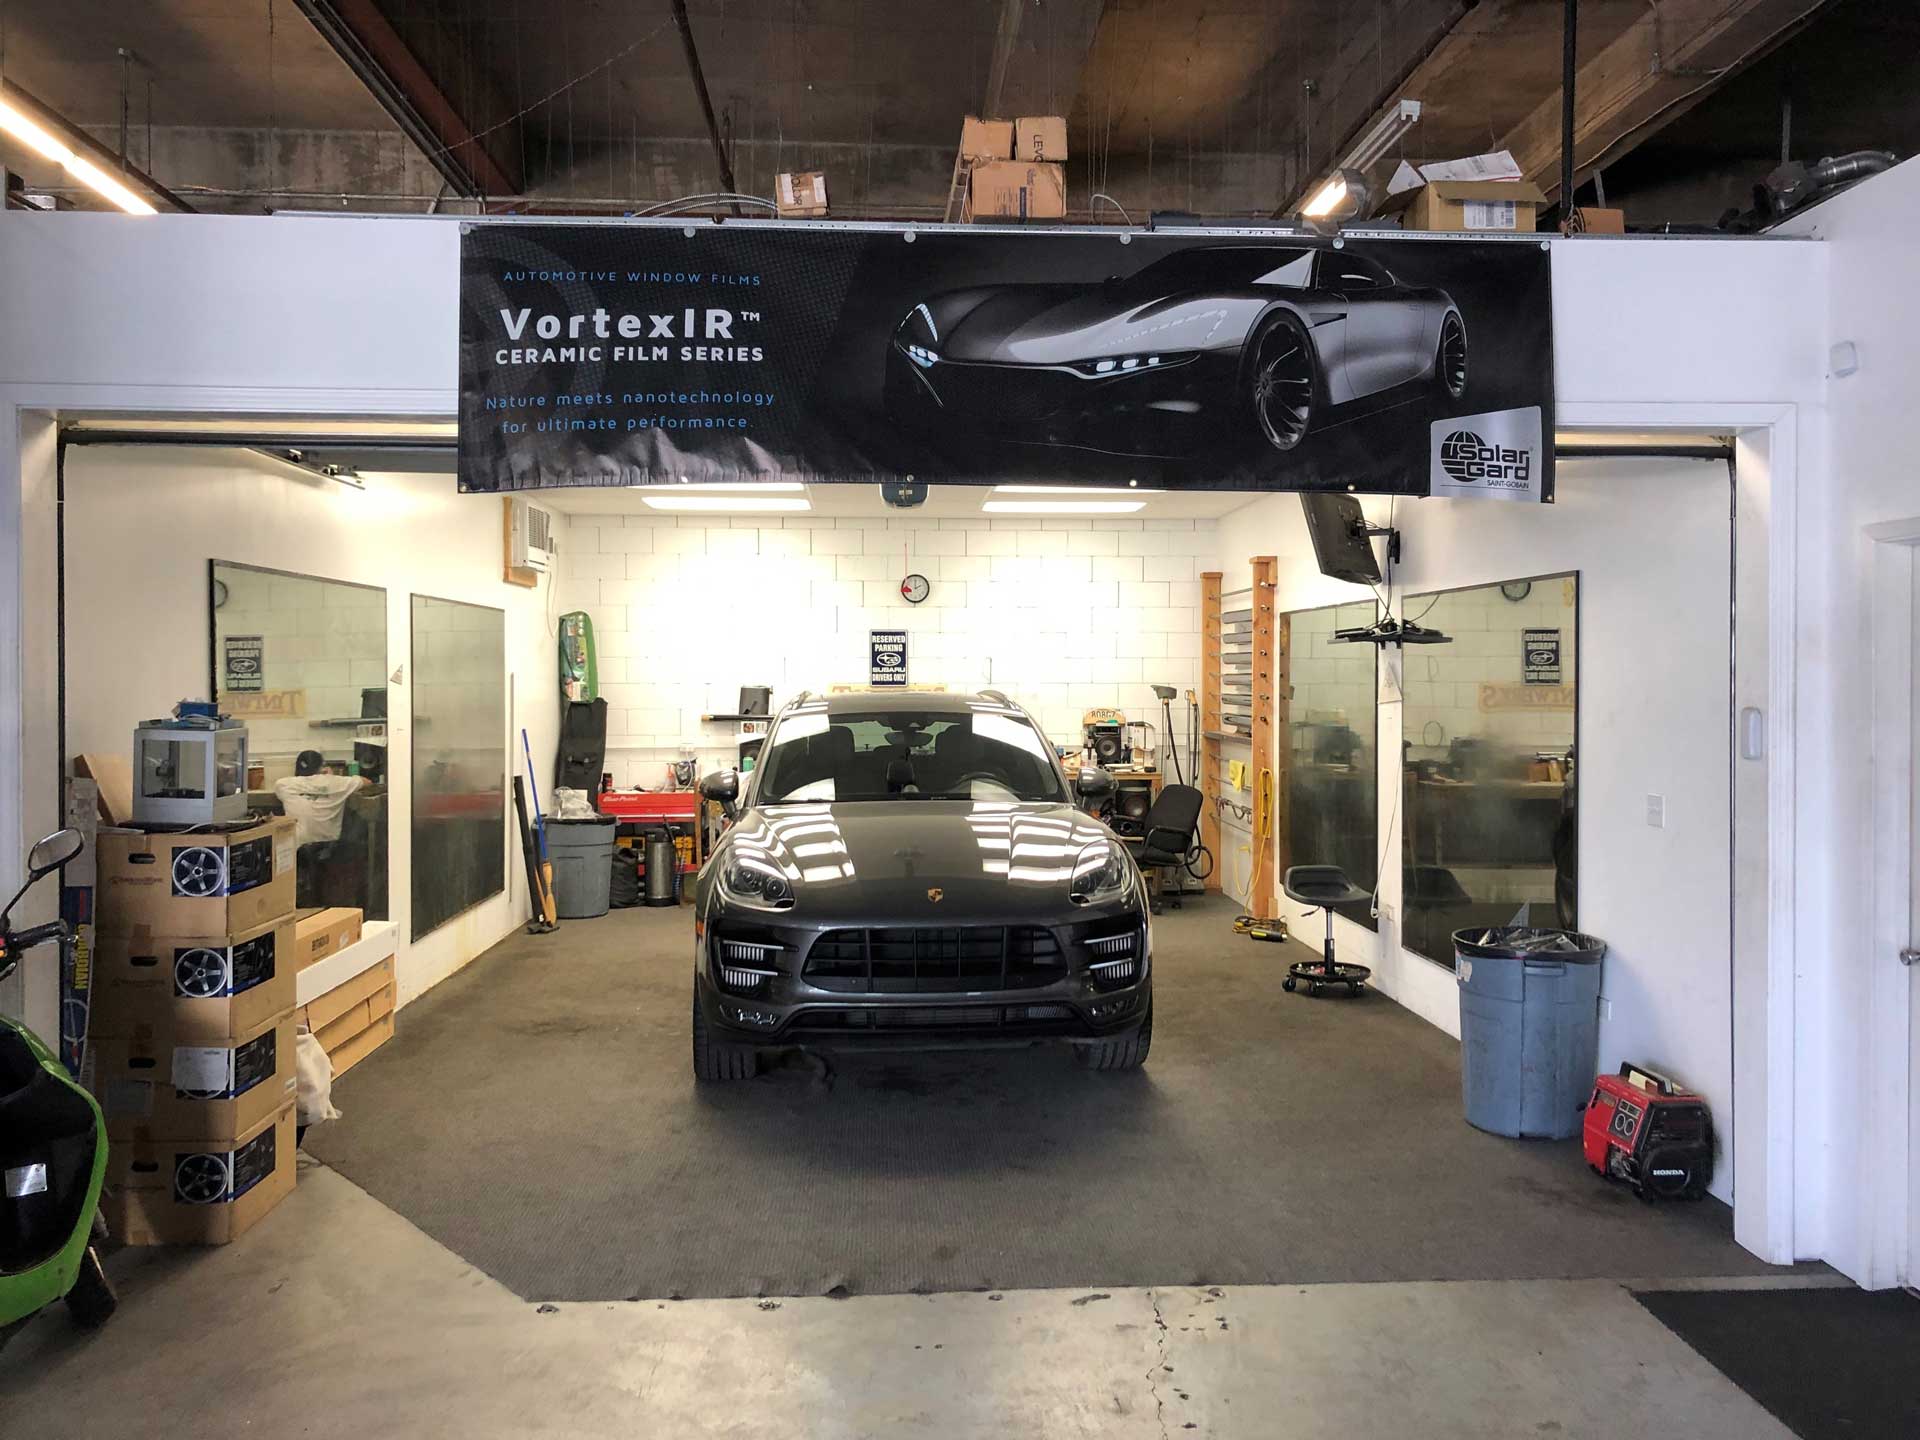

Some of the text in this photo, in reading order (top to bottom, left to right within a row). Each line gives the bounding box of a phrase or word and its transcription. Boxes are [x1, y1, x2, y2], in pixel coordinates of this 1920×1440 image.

[503, 271, 761, 286] AUTOMOTIVE WINDOW FILMS
[495, 346, 764, 365] CERAMIC FILM SERIES
[486, 390, 775, 410] Nature meets nanotechnology
[502, 421, 527, 434] for
[537, 417, 617, 433] ultimate
[1459, 444, 1529, 464] Solar
[1466, 456, 1530, 481] Gard
[1487, 480, 1529, 489] SAINT-GOBAIN
[872, 635, 906, 643] RESERVED
[874, 644, 903, 652] PARKING
